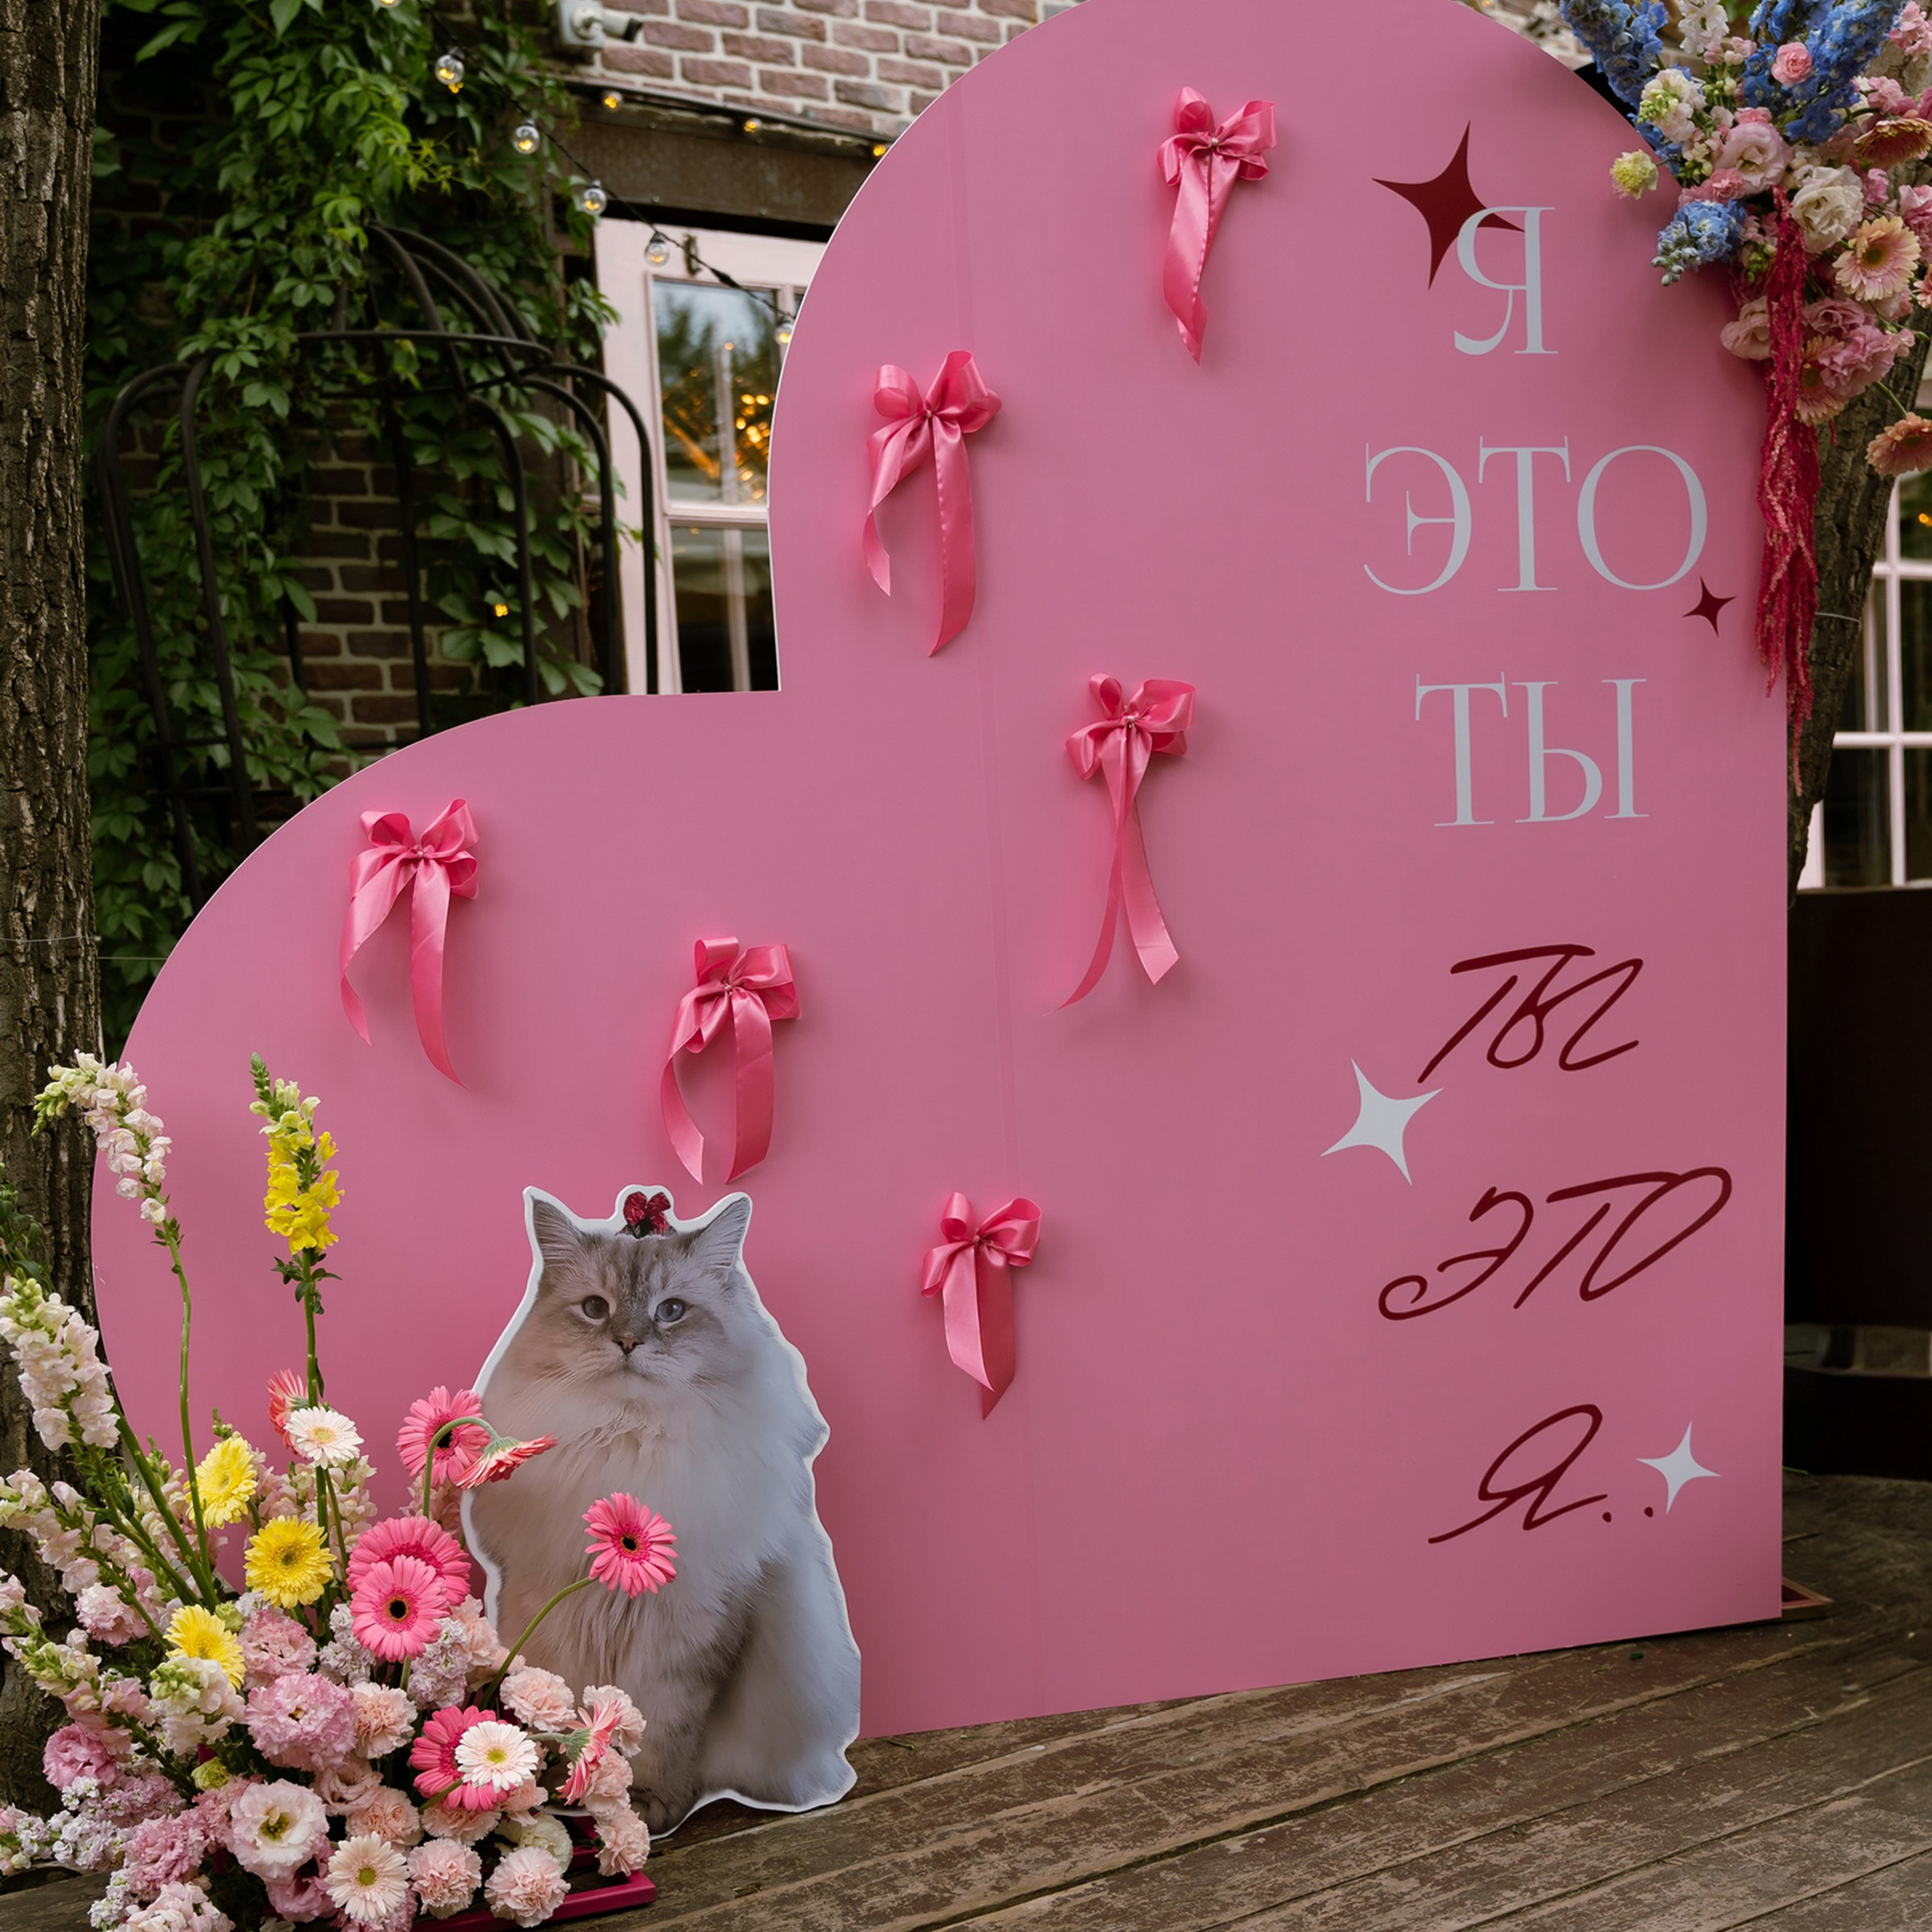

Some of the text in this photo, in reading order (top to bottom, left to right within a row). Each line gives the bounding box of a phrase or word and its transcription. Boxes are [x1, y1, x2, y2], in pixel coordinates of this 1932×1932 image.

[1454, 205, 1558, 355] Я
[1363, 435, 1708, 595] ЭТО
[1414, 672, 1649, 827] ТЫ
